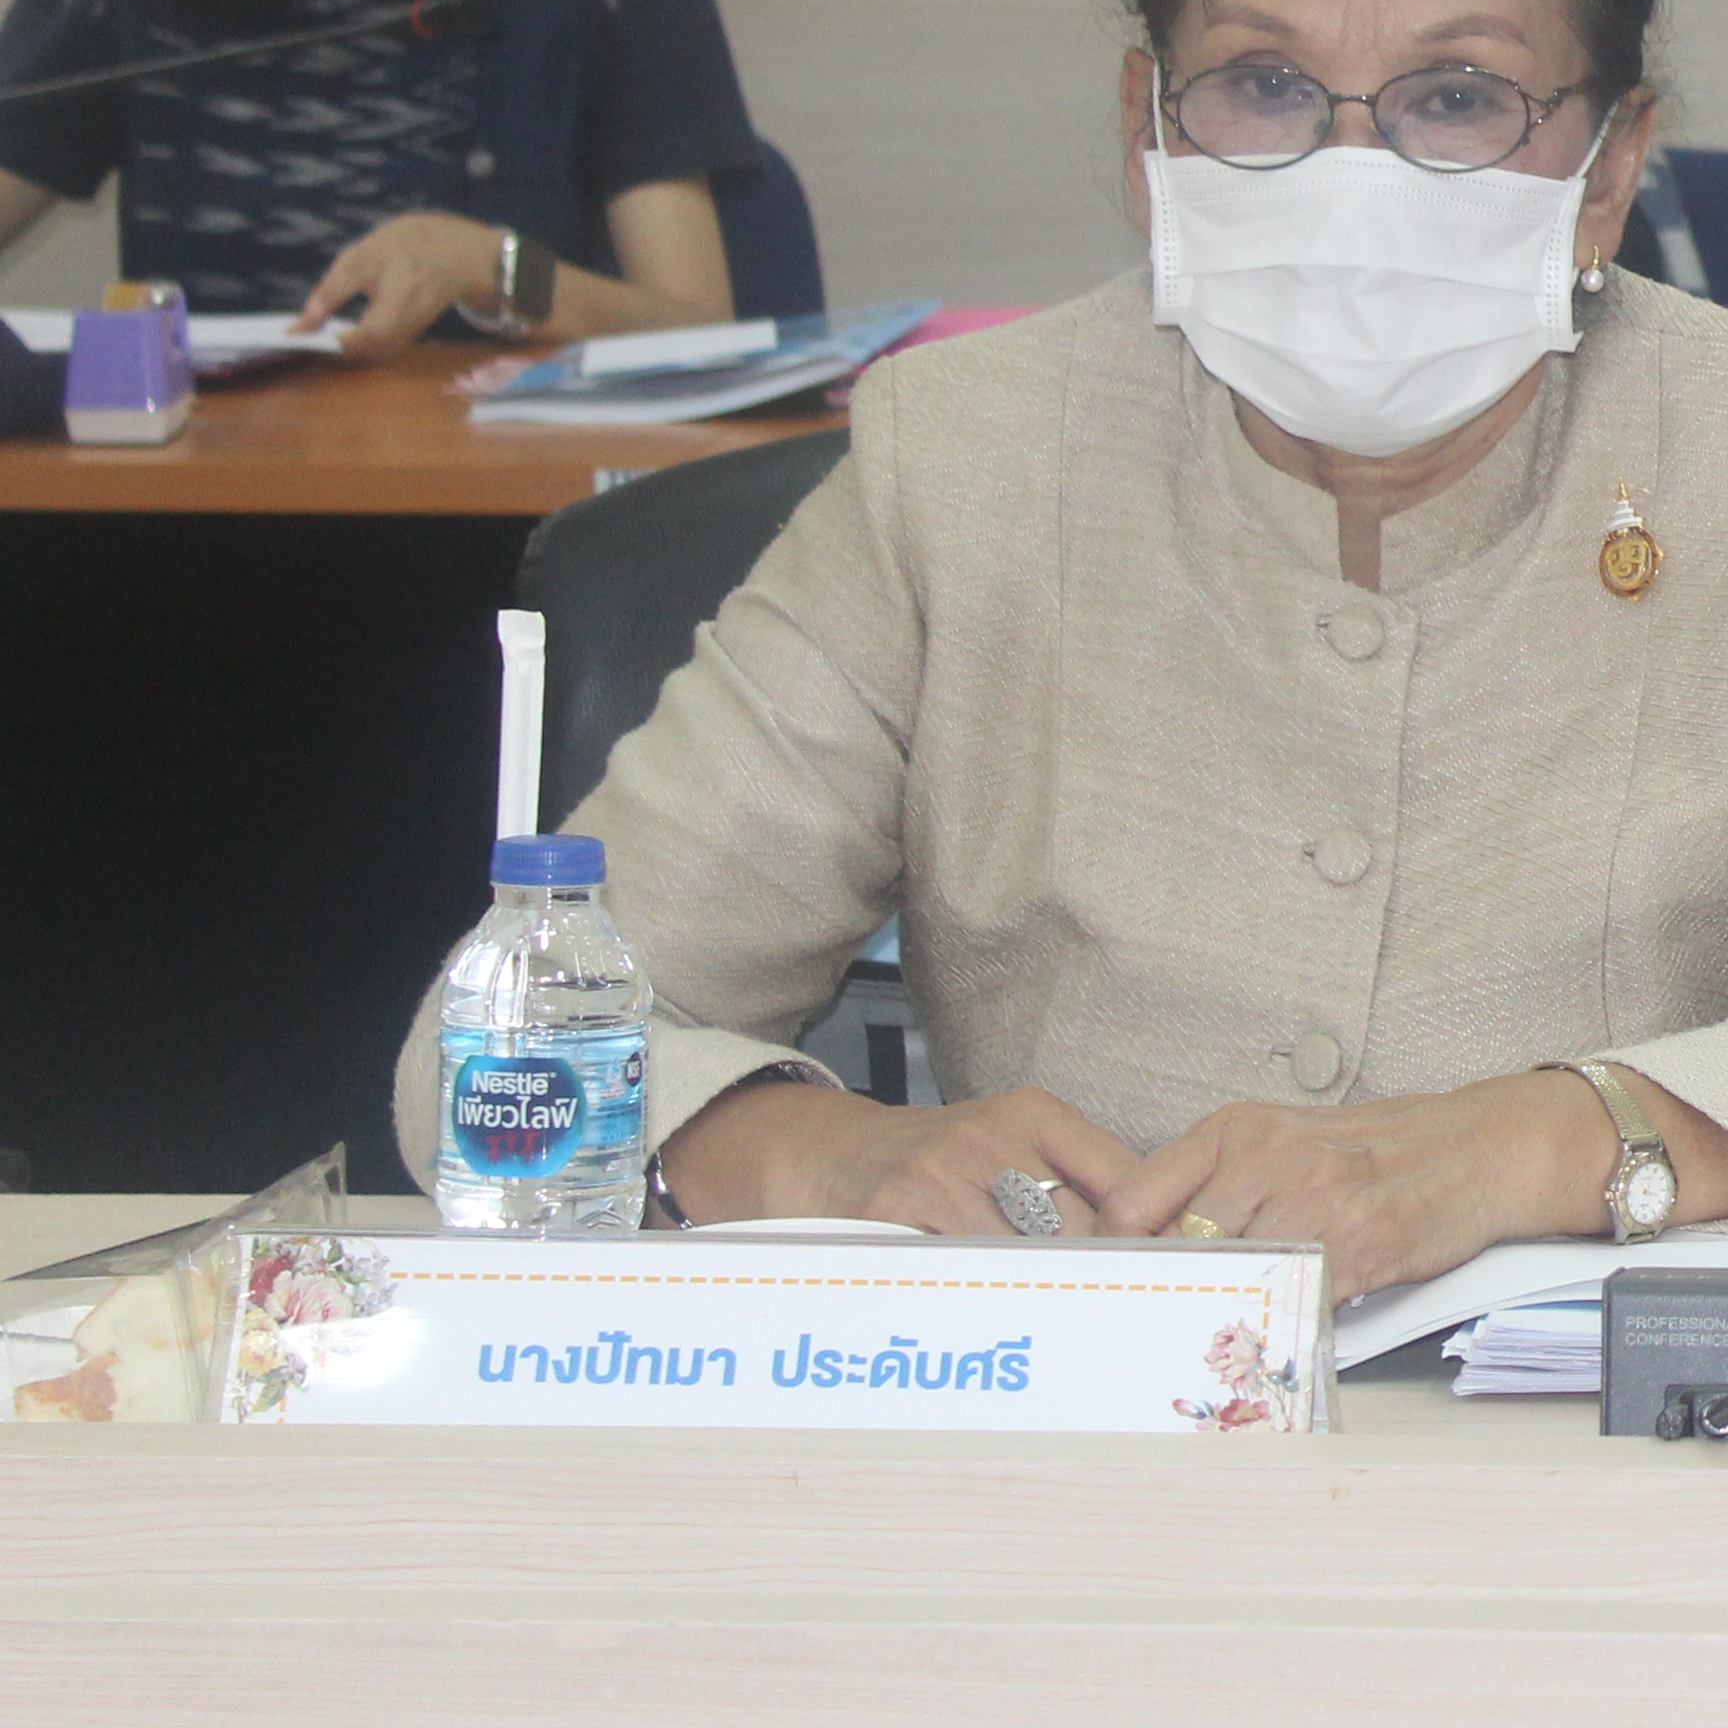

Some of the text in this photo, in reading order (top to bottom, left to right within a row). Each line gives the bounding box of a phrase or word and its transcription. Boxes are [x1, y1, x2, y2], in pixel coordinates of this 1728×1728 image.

[478, 1330, 1032, 1392] นางปัทมา ประดับศรี
